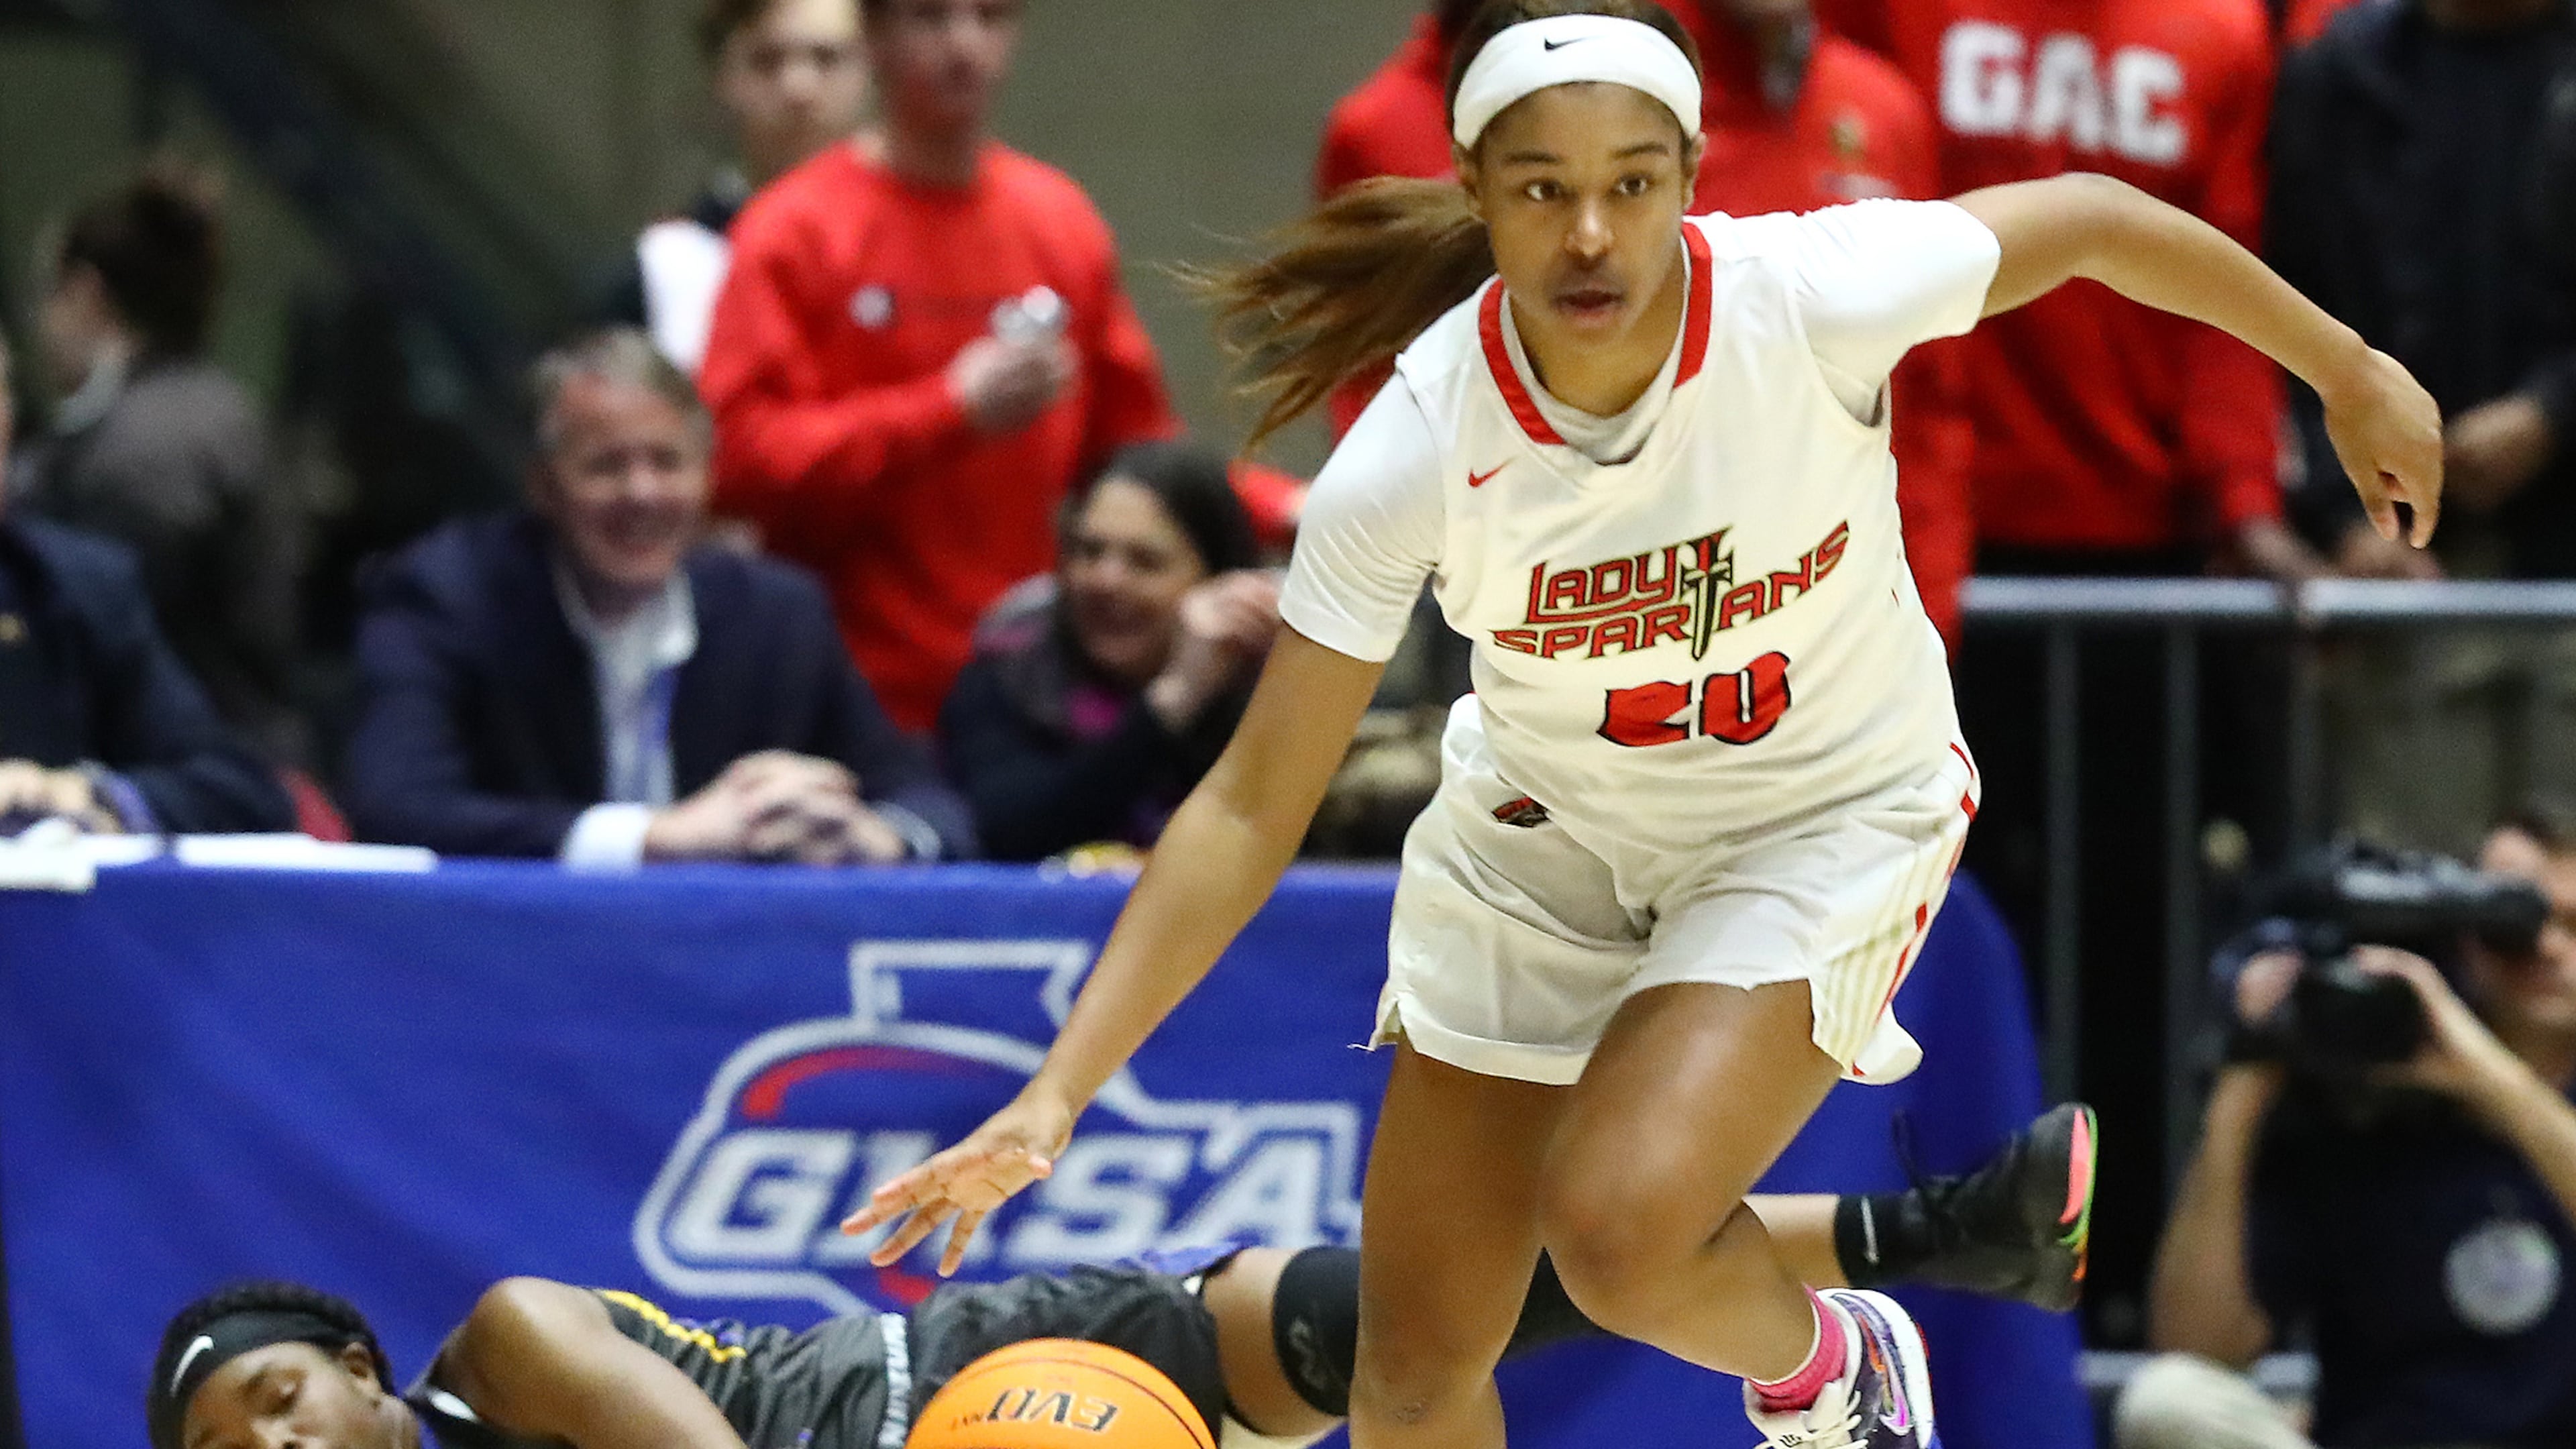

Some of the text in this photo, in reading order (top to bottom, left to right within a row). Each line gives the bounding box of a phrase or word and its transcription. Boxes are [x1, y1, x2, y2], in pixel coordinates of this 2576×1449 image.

[1939, 20, 2187, 165] GAC
[1523, 544, 1681, 625] LADY
[1596, 651, 1792, 748] 20
[986, 1389, 1118, 1432] EVO
